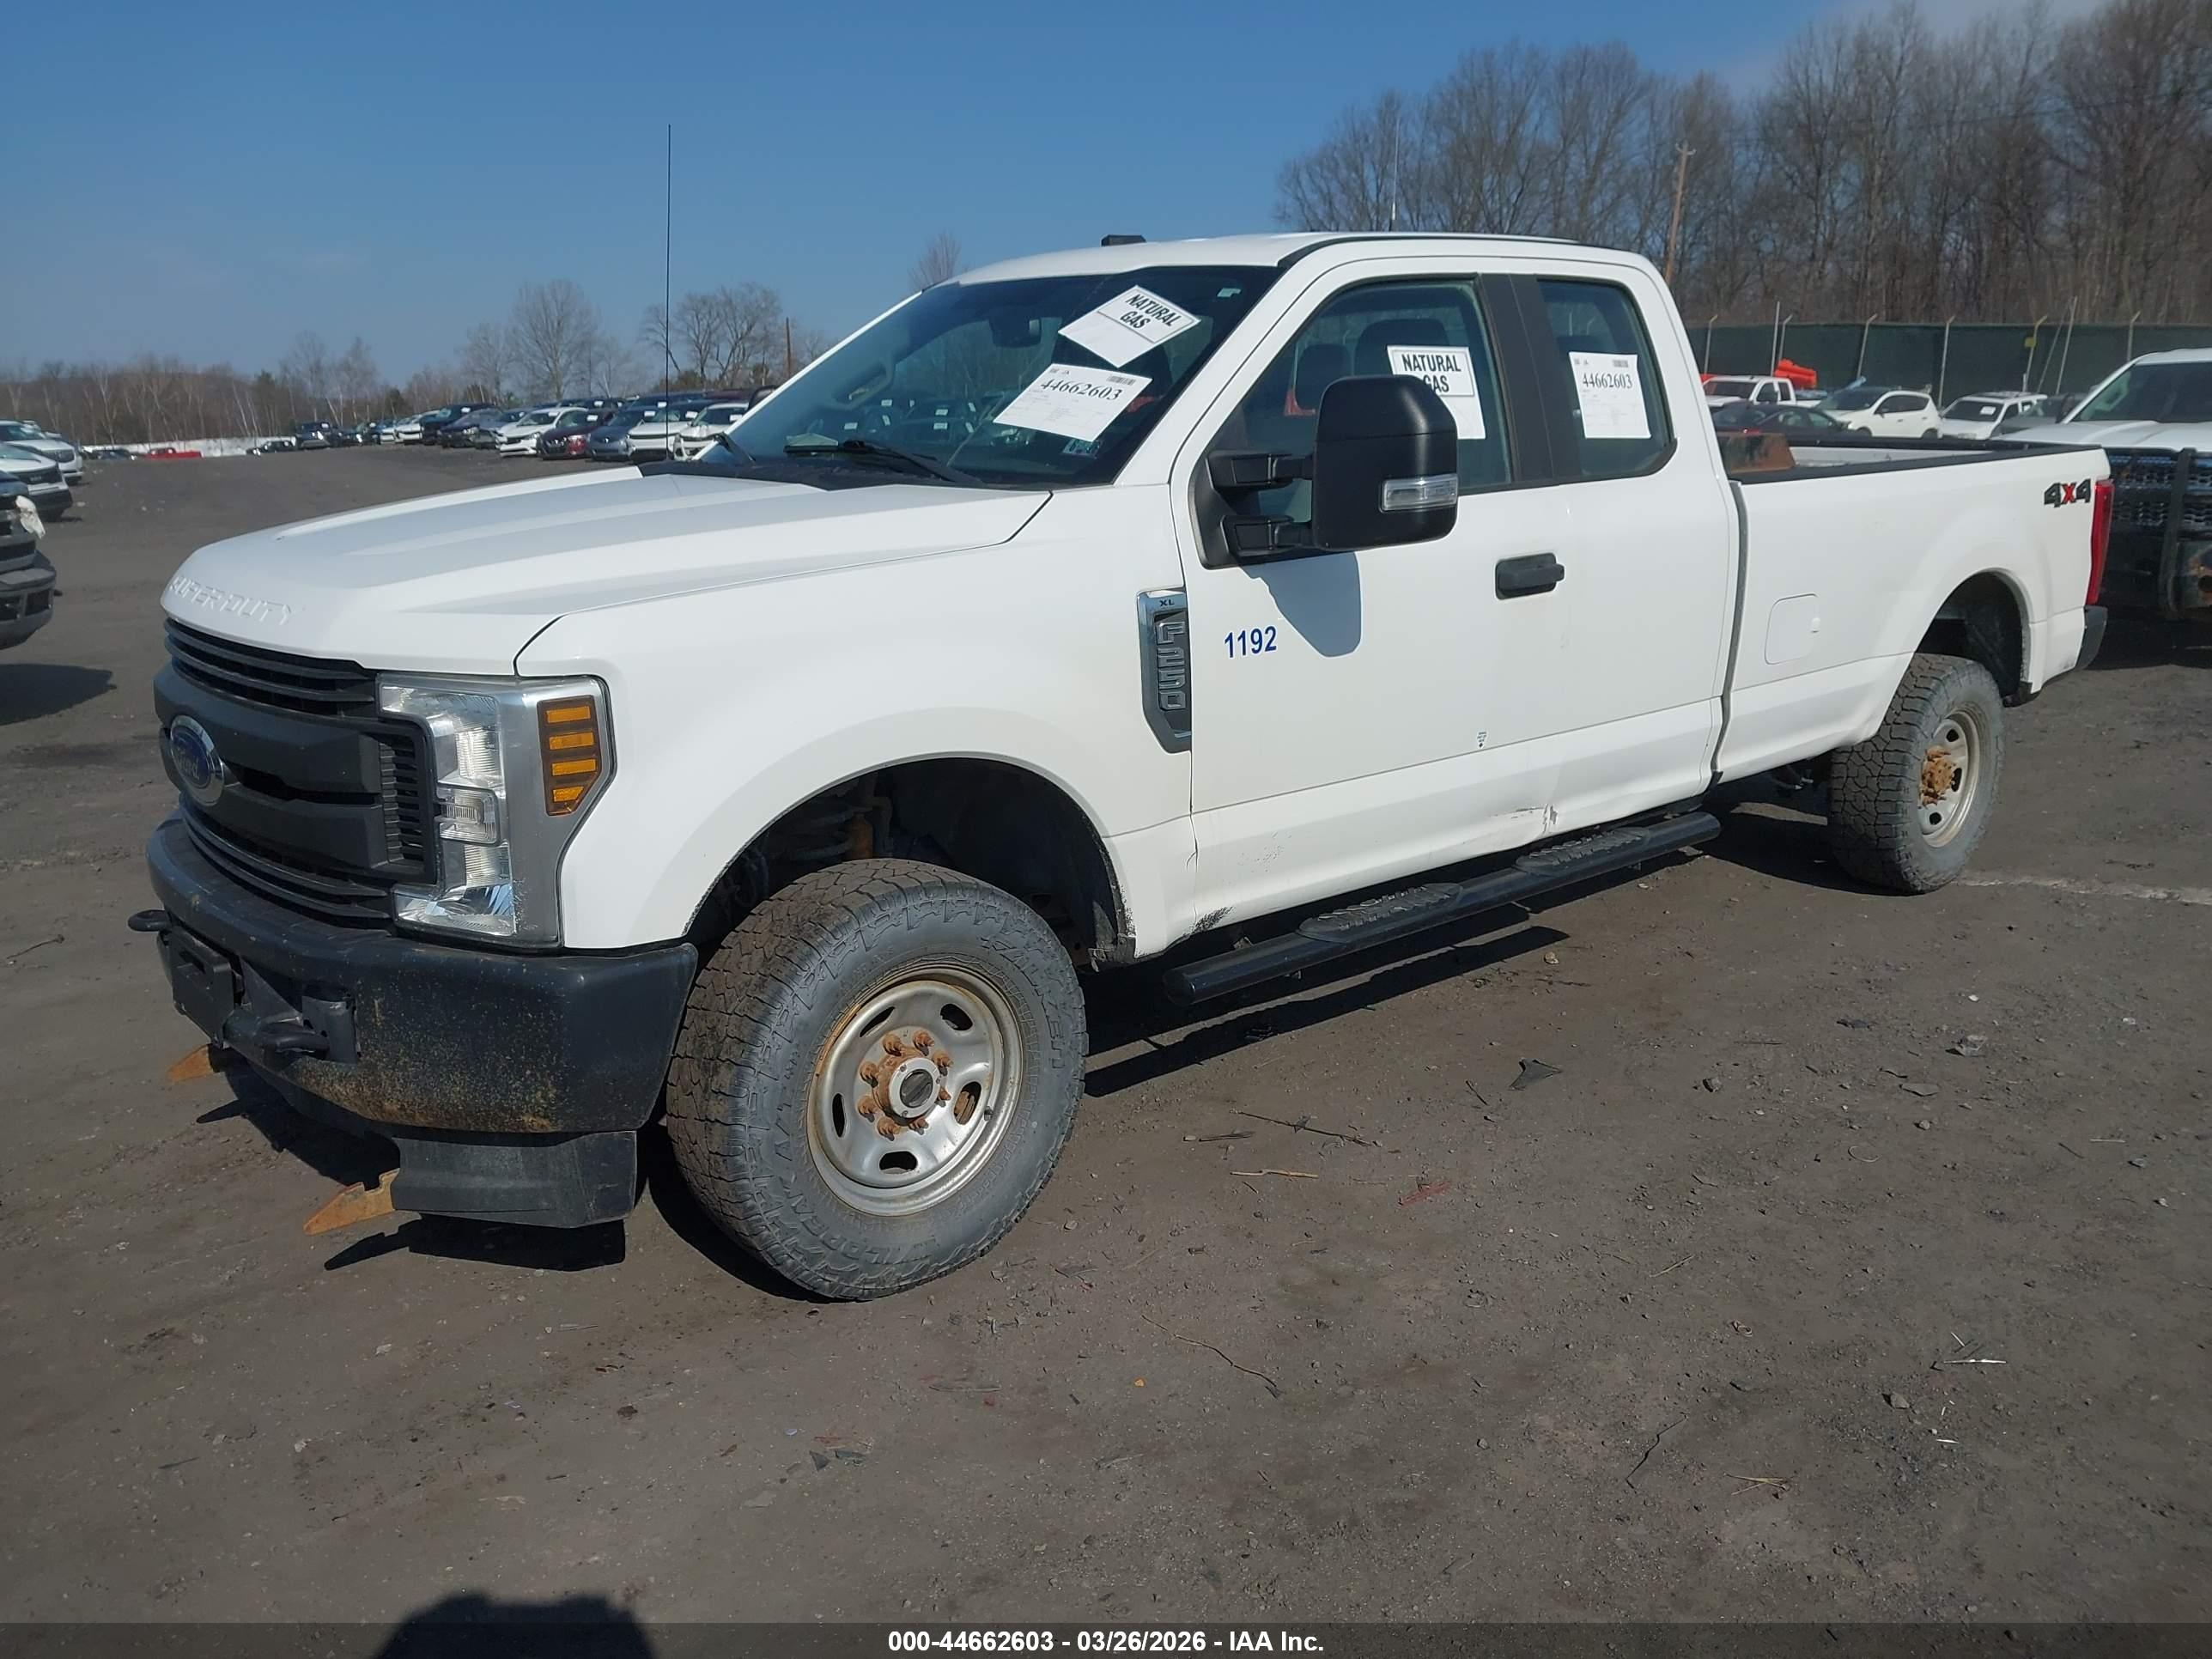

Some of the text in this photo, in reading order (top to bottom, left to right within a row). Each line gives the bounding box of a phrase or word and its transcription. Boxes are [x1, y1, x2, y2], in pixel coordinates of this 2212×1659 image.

[1120, 311, 1151, 328] GAS
[1125, 294, 1182, 326] NATURAL
[1401, 353, 1462, 372] NATURAL
[1041, 378, 1122, 400] 44662603
[1583, 373, 1633, 389] 44662603
[219, 593, 292, 625] DUTY
[1224, 625, 1278, 659] 1192
